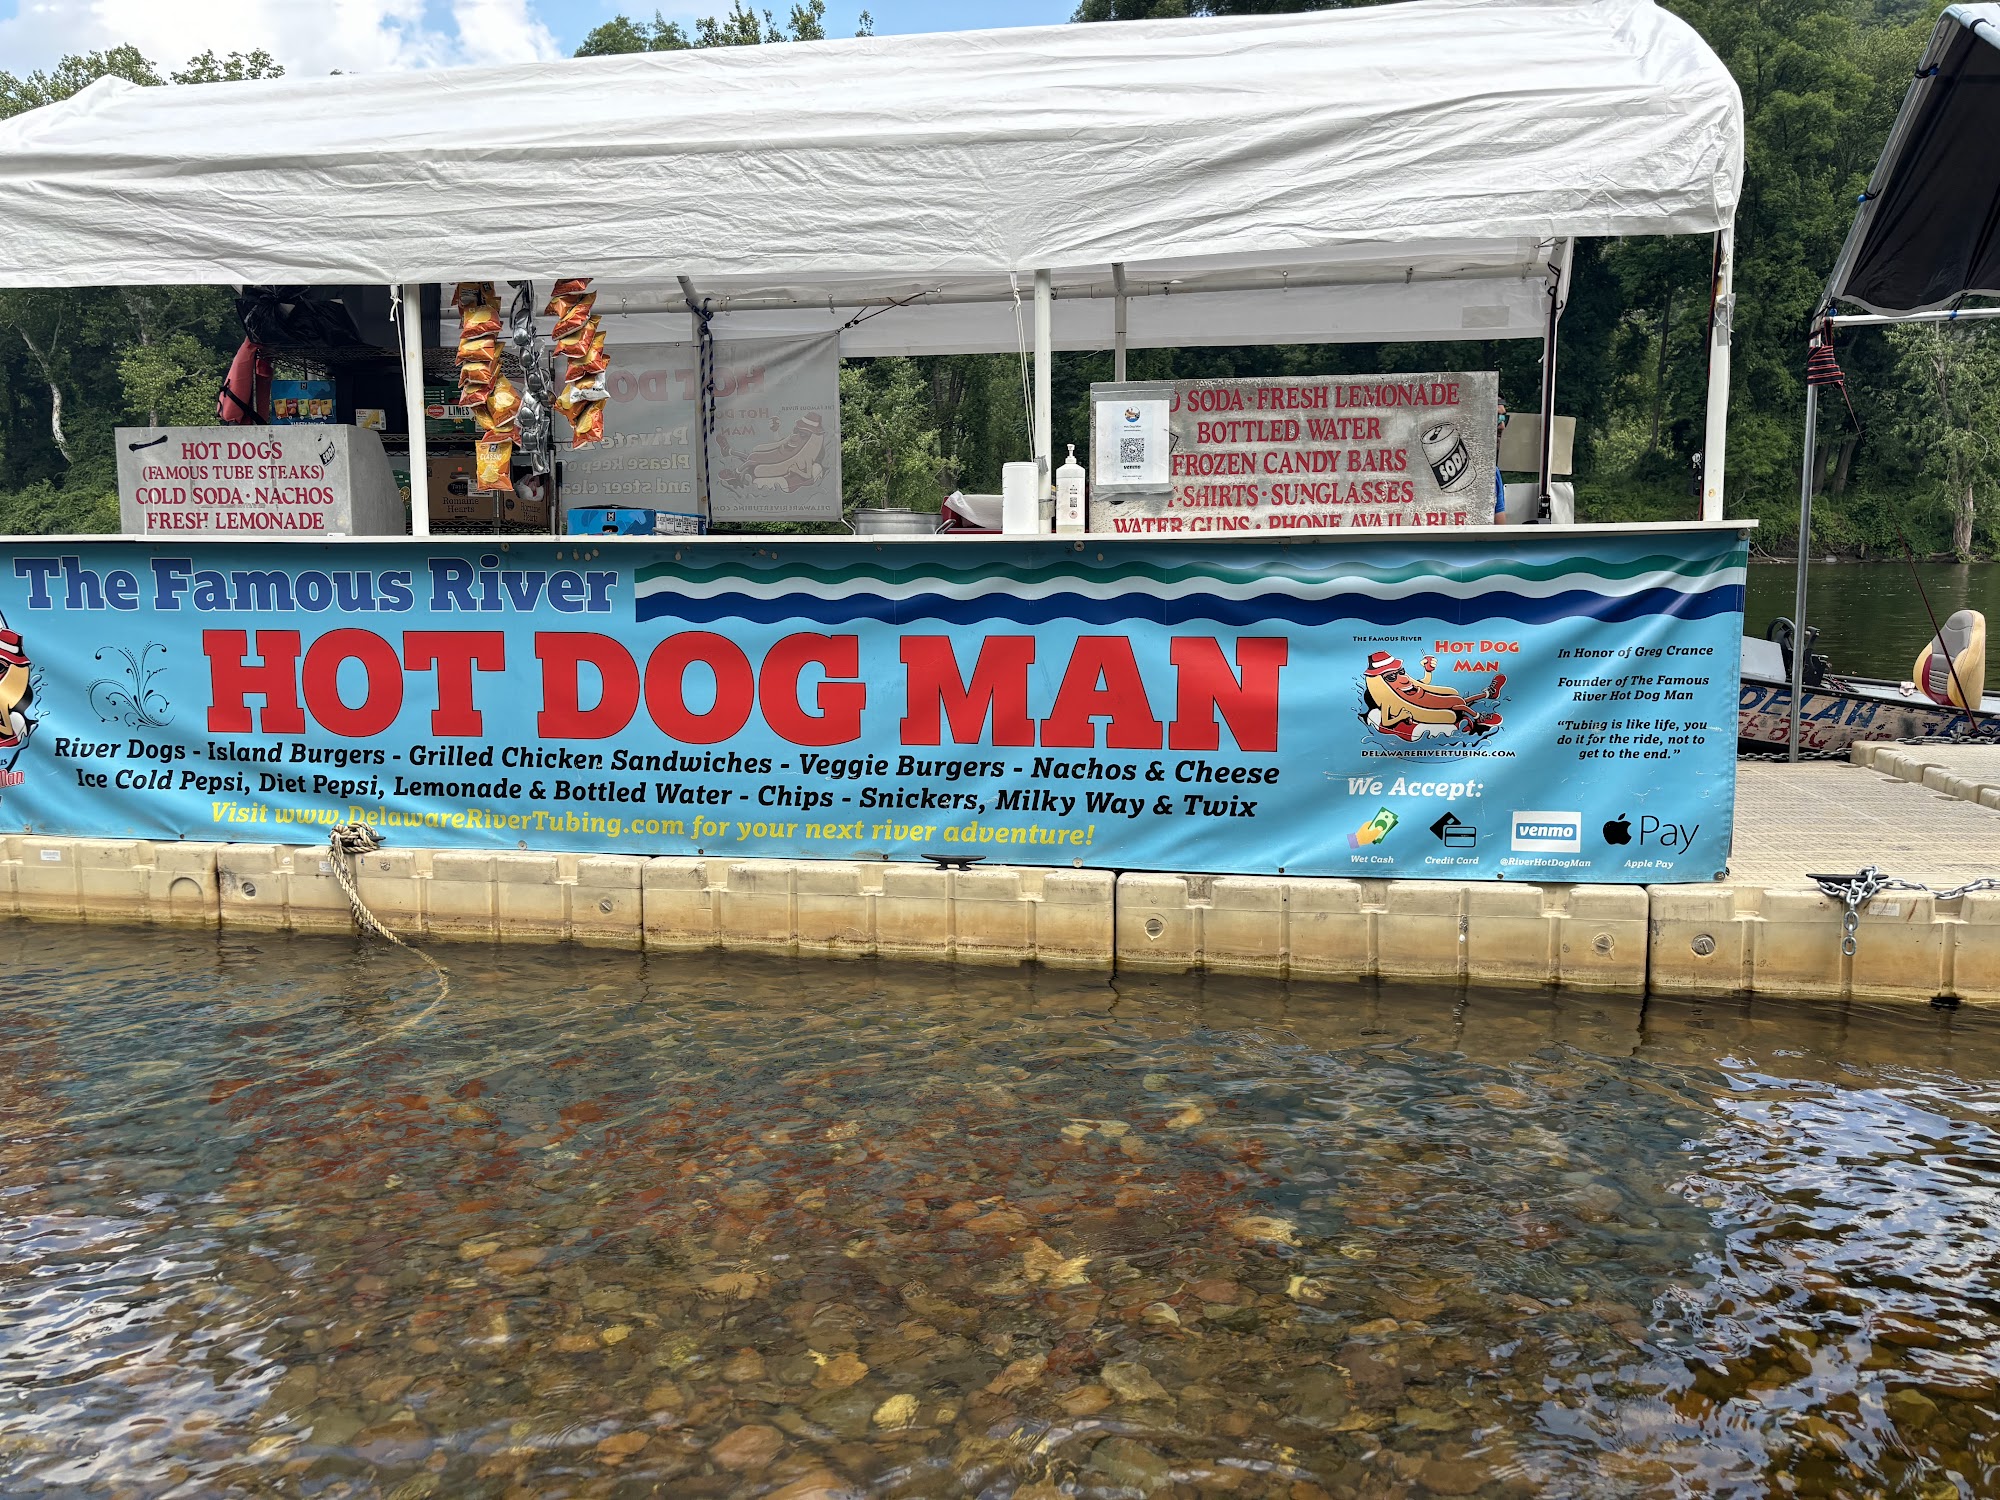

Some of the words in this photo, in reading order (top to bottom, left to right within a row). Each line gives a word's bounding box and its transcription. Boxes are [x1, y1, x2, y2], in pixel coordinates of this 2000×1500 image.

[1187, 388, 1244, 413] SODA
[1257, 386, 1328, 410] FRESH
[1335, 383, 1460, 408] LEMONADE
[448, 406, 470, 416] LIMES
[1197, 418, 1300, 444] BOTTLED
[1306, 417, 1382, 441] WATER
[182, 442, 222, 460] HOT
[228, 442, 282, 460] DOGS
[1172, 452, 1256, 476] FROZEN
[1264, 450, 1341, 474] CANDY
[1347, 448, 1407, 472] BARS
[1438, 444, 1468, 482] SODA
[142, 466, 208, 482] (FAMOUS
[213, 466, 254, 480] TUBE
[258, 465, 324, 482] STEAKS)
[136, 487, 186, 505] COLD
[192, 487, 243, 505] SODA
[255, 487, 334, 505] NACHOS
[443, 497, 479, 505] Romaine
[1271, 481, 1414, 506] SUNGLASSES
[147, 512, 208, 530] FRESH
[216, 512, 324, 530] LEMONADE
[1113, 517, 1183, 534] WATER
[13, 555, 140, 612] The
[150, 558, 415, 612] Famous
[428, 554, 618, 613] River
[1435, 640, 1475, 653] HOT
[1480, 640, 1520, 653] DOG
[1558, 648, 1571, 658] In
[1574, 648, 1614, 658] Honor
[1618, 646, 1632, 658] of
[1635, 646, 1663, 658] Greg
[1666, 646, 1714, 656] Crance
[1453, 660, 1500, 672] MAN
[203, 628, 506, 738] HOT
[534, 630, 866, 746] DOG
[900, 635, 1288, 752] MAN
[1558, 676, 1612, 688] Founder
[1616, 676, 1630, 688] of
[1631, 675, 1654, 686] The
[1656, 675, 1710, 686] Famous
[1572, 691, 1607, 702] River
[1610, 690, 1631, 701] Hot
[1634, 690, 1660, 702] Dog
[1664, 690, 1694, 700] Man
[1558, 720, 1608, 732] “Tubing
[1611, 719, 1622, 730] is
[1626, 719, 1650, 730] like
[1654, 719, 1680, 732] life,
[1684, 720, 1708, 732] you
[1557, 734, 1572, 744] do
[1576, 734, 1584, 744] it
[1586, 734, 1606, 746] for
[1609, 734, 1630, 744] the
[1633, 734, 1664, 746] ride,
[1668, 734, 1689, 744] not
[1692, 734, 1705, 744] to
[54, 738, 121, 758] River
[126, 738, 186, 764] Dogs
[208, 741, 282, 763] Island
[290, 743, 384, 768] Burgers
[409, 744, 494, 768] Grilled
[501, 746, 604, 770] Chicken
[610, 750, 772, 774] Sandwiches
[800, 753, 890, 780] Veggie
[895, 755, 1004, 781] Burgers
[1030, 757, 1137, 782] Nachos
[1144, 760, 1165, 782] &
[1174, 760, 1280, 785] Cheese
[1361, 750, 1516, 758] DELAWARERIVERTUBING.COM
[1578, 748, 1600, 760] get
[1602, 749, 1614, 758] to
[1618, 748, 1640, 759] the
[76, 768, 108, 788] Ice
[115, 769, 174, 790] Cold
[179, 770, 252, 796] Pepsi,
[258, 772, 306, 793] Diet
[312, 774, 384, 800] Pepsi,
[394, 776, 522, 800] Lemonade
[529, 780, 547, 800] &
[554, 780, 647, 804] Bottled
[655, 783, 733, 806] Water
[758, 785, 834, 811] Chips
[859, 787, 986, 816] Snickers,
[995, 790, 1076, 817] Milky
[1085, 791, 1145, 819] Way
[1153, 795, 1173, 816] &
[1183, 794, 1258, 818] Twix
[1348, 776, 1384, 796] We
[1388, 776, 1484, 801] Accept:
[212, 802, 268, 823] Visit
[275, 805, 684, 838] www.DelawareRiverTubing.com
[691, 816, 730, 840] for
[737, 822, 798, 842] your
[805, 821, 864, 840] next
[872, 820, 936, 842] river
[943, 821, 1096, 845] adventure!
[1519, 824, 1574, 838] venmo
[1640, 815, 1700, 855] Pay
[1350, 854, 1368, 864] Wet
[1370, 856, 1394, 864] Cash
[1425, 856, 1454, 865] Credit
[1456, 856, 1480, 865] Card
[1500, 857, 1592, 868] @RiverHotDogMan
[1624, 859, 1653, 868] Apple
[1655, 860, 1674, 870] Pay
